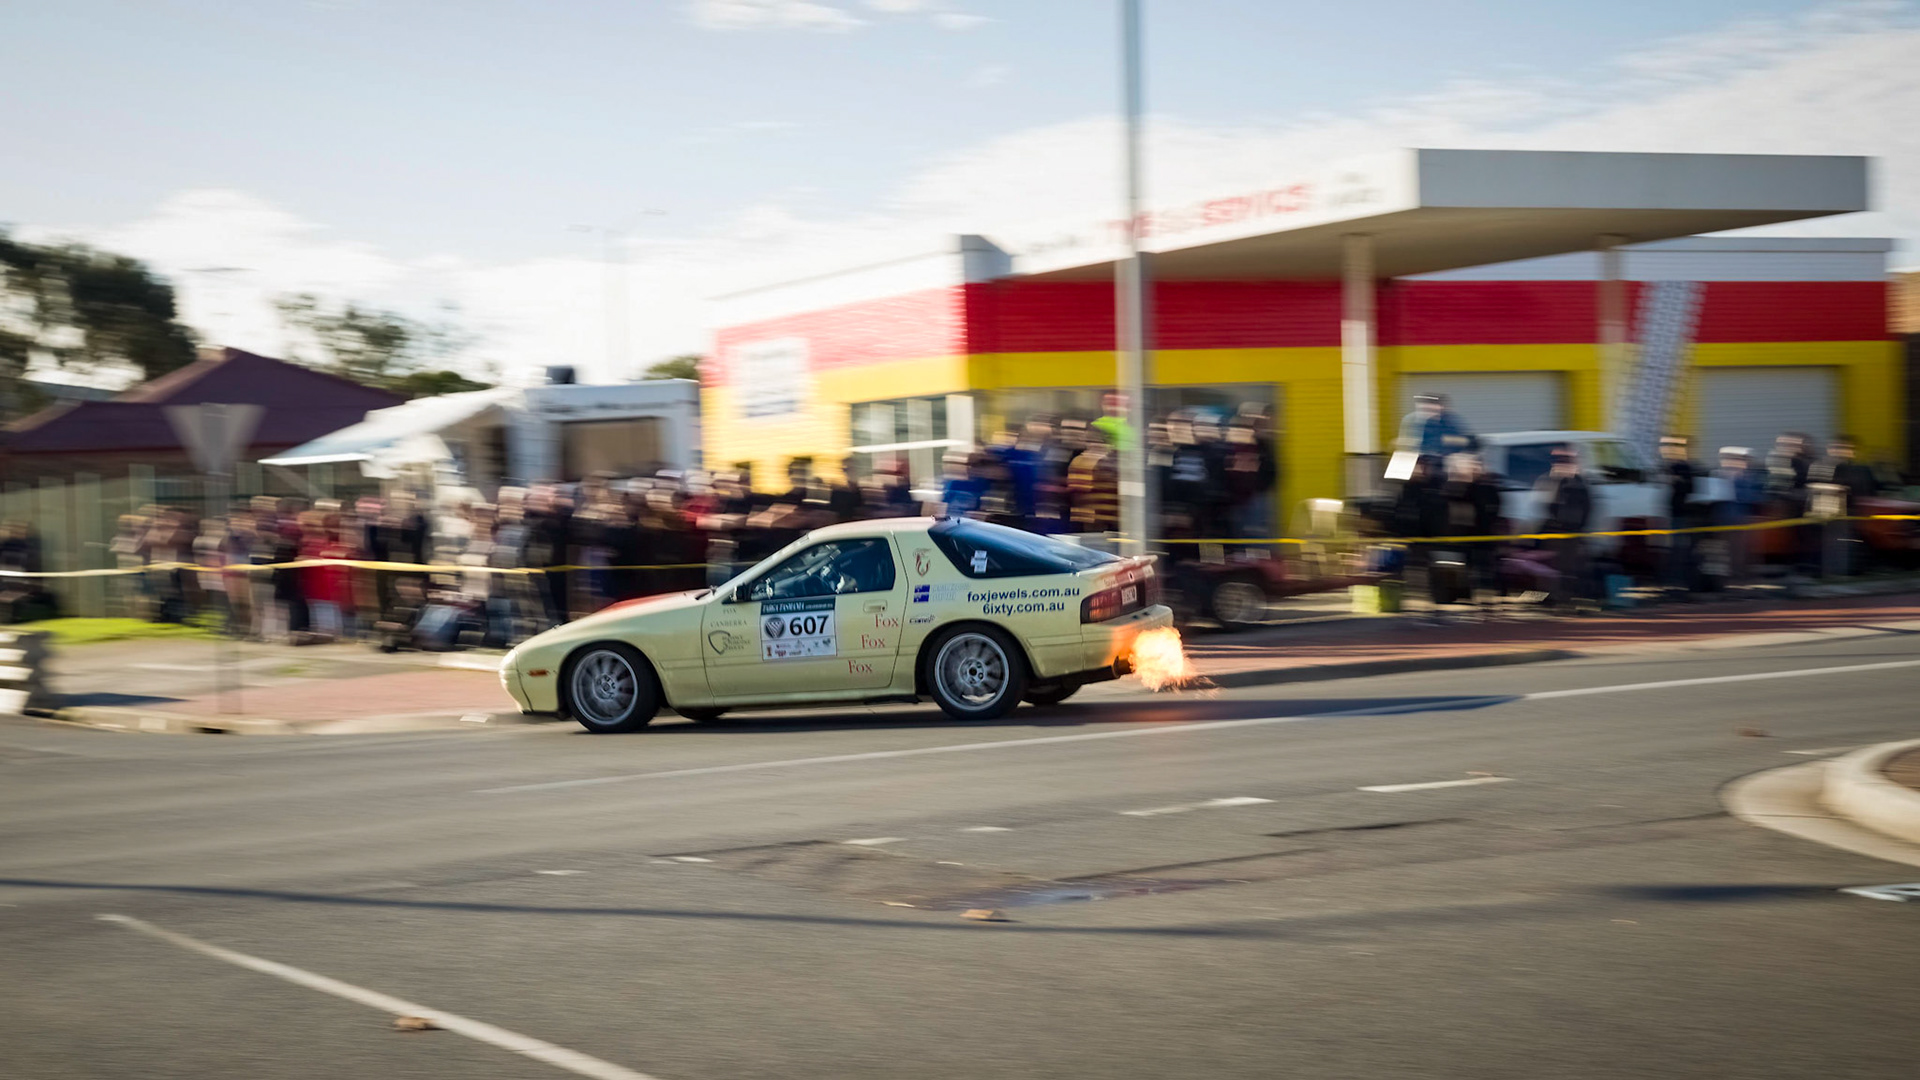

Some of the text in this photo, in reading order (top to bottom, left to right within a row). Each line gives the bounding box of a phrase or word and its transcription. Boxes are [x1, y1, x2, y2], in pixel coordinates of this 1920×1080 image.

[967, 587, 1080, 603] foxjewels.com.au
[982, 602, 1065, 616] 6ixty.com.au
[789, 615, 829, 636] 607
[875, 613, 899, 628] Fox
[861, 634, 885, 649] Fox
[848, 659, 873, 674] Fox
